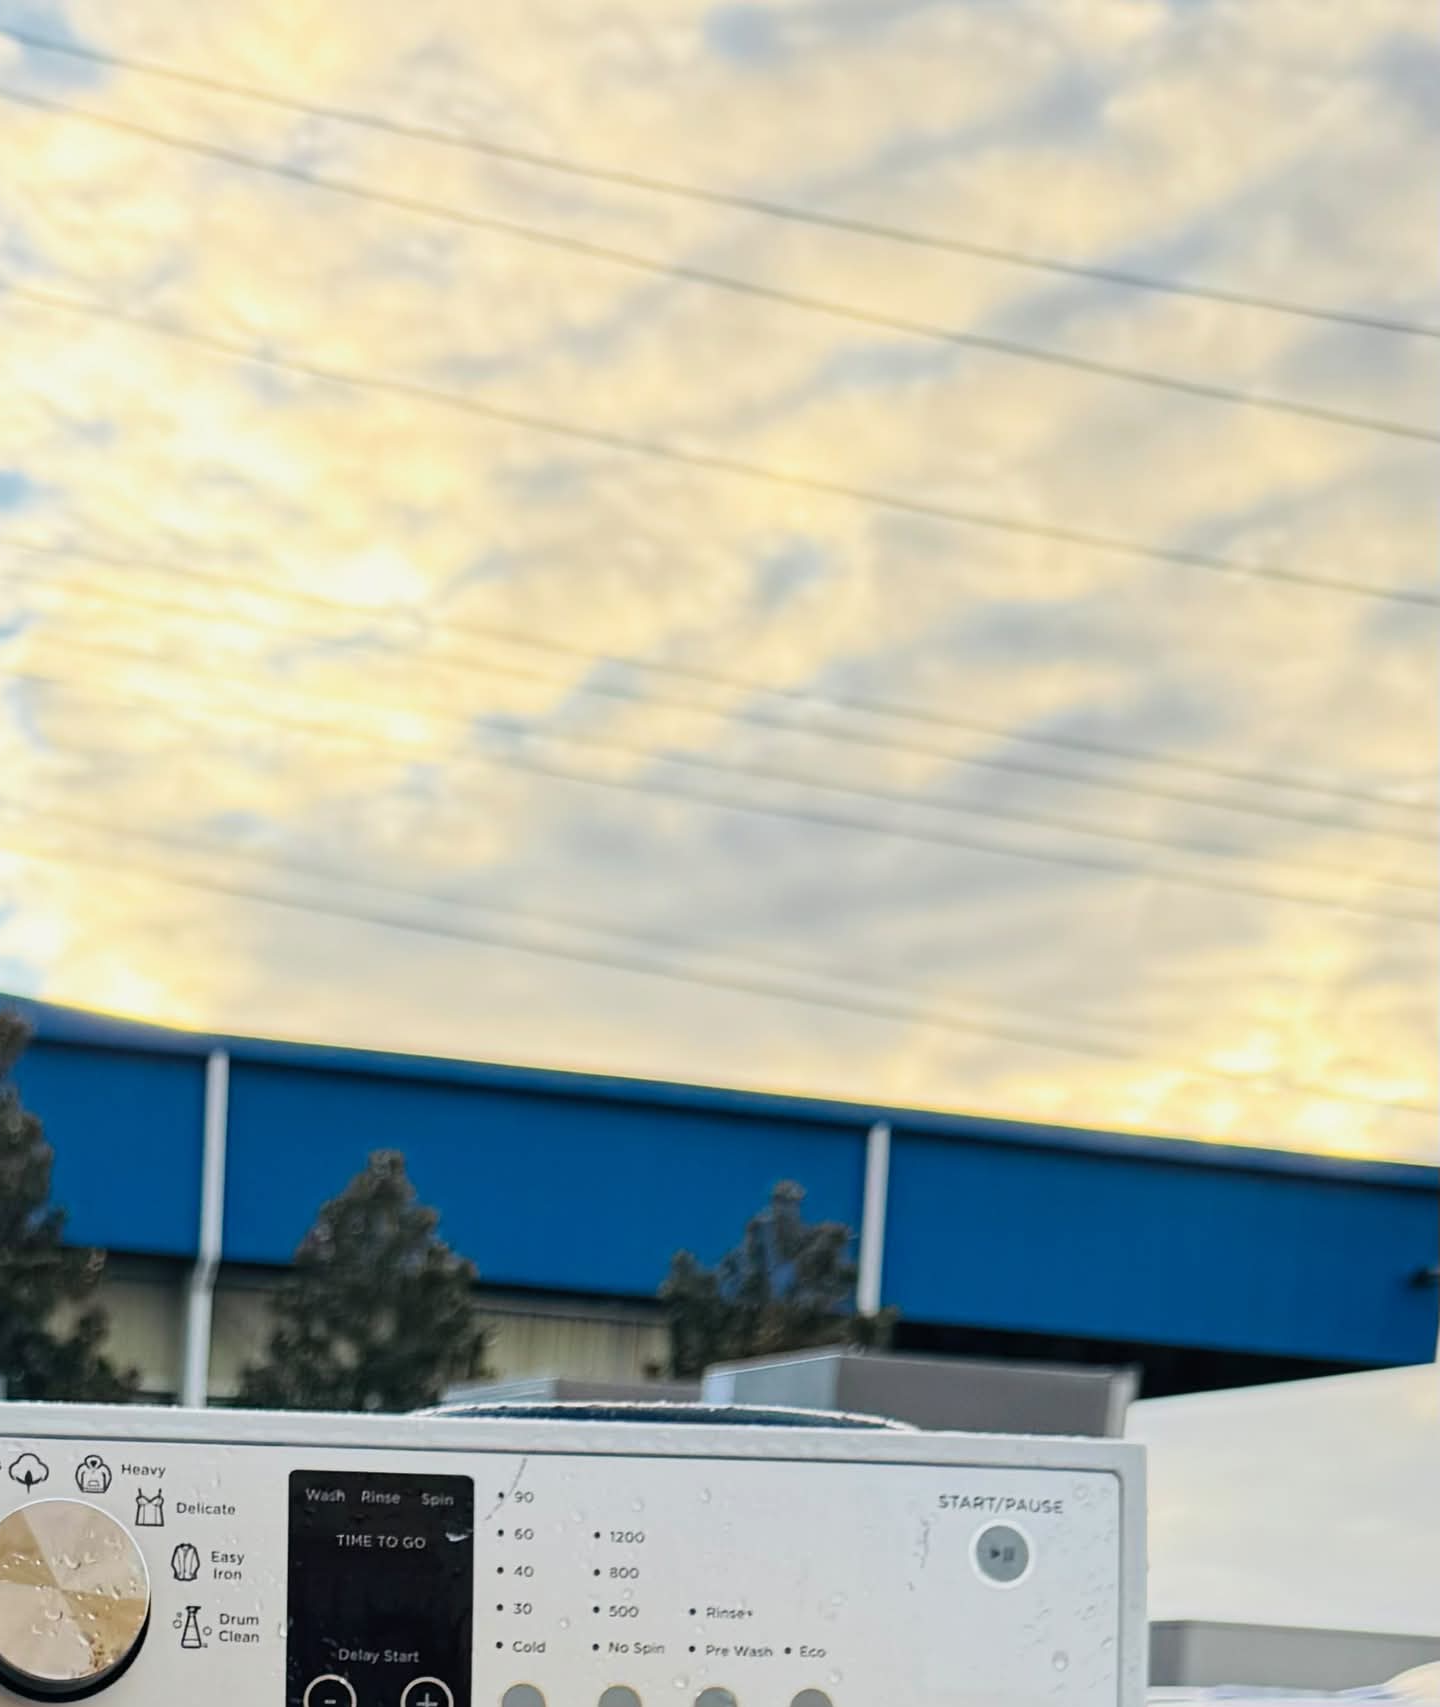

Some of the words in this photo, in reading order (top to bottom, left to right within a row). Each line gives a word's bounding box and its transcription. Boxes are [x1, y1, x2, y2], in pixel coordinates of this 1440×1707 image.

[121, 1464, 166, 1479] Heavy
[305, 1488, 346, 1502] Wash
[361, 1490, 401, 1505] Rinse
[421, 1493, 454, 1507] Spin
[514, 1491, 535, 1504] 90
[938, 1494, 1064, 1514] START/PAUSE
[176, 1502, 236, 1516] Delicate
[514, 1528, 535, 1541] 60
[610, 1531, 645, 1544] 1200
[336, 1534, 372, 1548] TIME
[377, 1535, 398, 1549] TO
[402, 1536, 426, 1550] GO
[211, 1551, 245, 1566] Easy
[213, 1568, 242, 1581] Iron
[513, 1565, 534, 1578] 40
[610, 1567, 640, 1580] 800
[513, 1603, 533, 1615] 30
[609, 1605, 640, 1618] 500
[219, 1613, 260, 1626] Drum
[219, 1630, 260, 1643] Clean
[512, 1641, 547, 1654] Cold
[608, 1641, 629, 1654] No
[633, 1642, 666, 1656] Spin
[705, 1644, 730, 1657] Pre
[733, 1645, 774, 1658] Wash
[799, 1645, 827, 1658] Eco
[338, 1648, 380, 1665] Delay
[383, 1649, 420, 1663] Start
